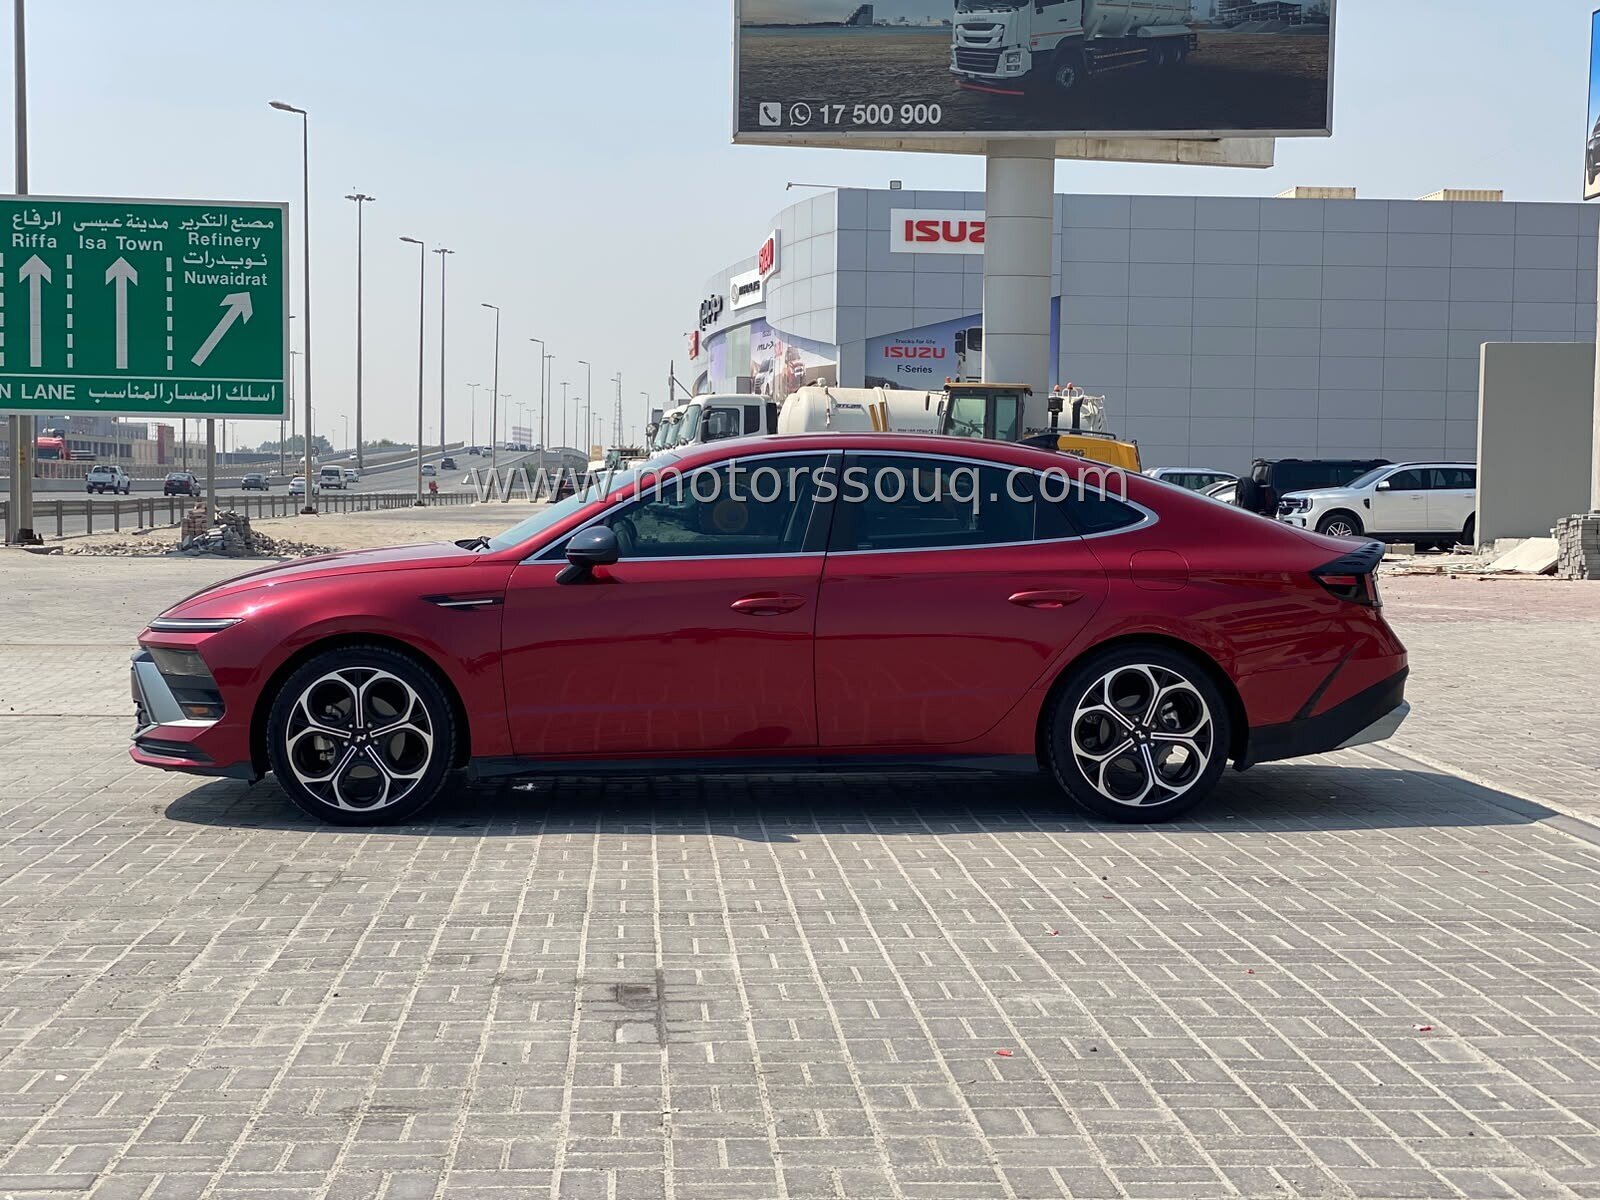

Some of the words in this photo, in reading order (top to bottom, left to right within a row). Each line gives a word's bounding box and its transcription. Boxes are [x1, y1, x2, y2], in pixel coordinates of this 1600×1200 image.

[819, 104, 846, 124] 17
[852, 104, 894, 125] 500
[900, 104, 942, 125] 900
[12, 208, 61, 230] الرفاع
[73, 217, 122, 232] عيسى
[126, 213, 169, 232] مدينة
[178, 212, 227, 231] التكرير
[230, 217, 274, 232] مصنع
[905, 219, 985, 243] ISUZ
[12, 233, 57, 248] Riffa
[79, 235, 107, 250] Isa
[115, 235, 163, 251] Town
[188, 231, 261, 249] Refinery
[182, 250, 268, 269] نويدرات
[184, 270, 268, 286] Nuwaidrat
[883, 346, 946, 359] ISUZU
[896, 364, 933, 374] F-Series
[21, 383, 76, 400] LANE
[88, 381, 163, 404] المناسب
[163, 382, 221, 404] المسار
[225, 384, 276, 401] اسلك
